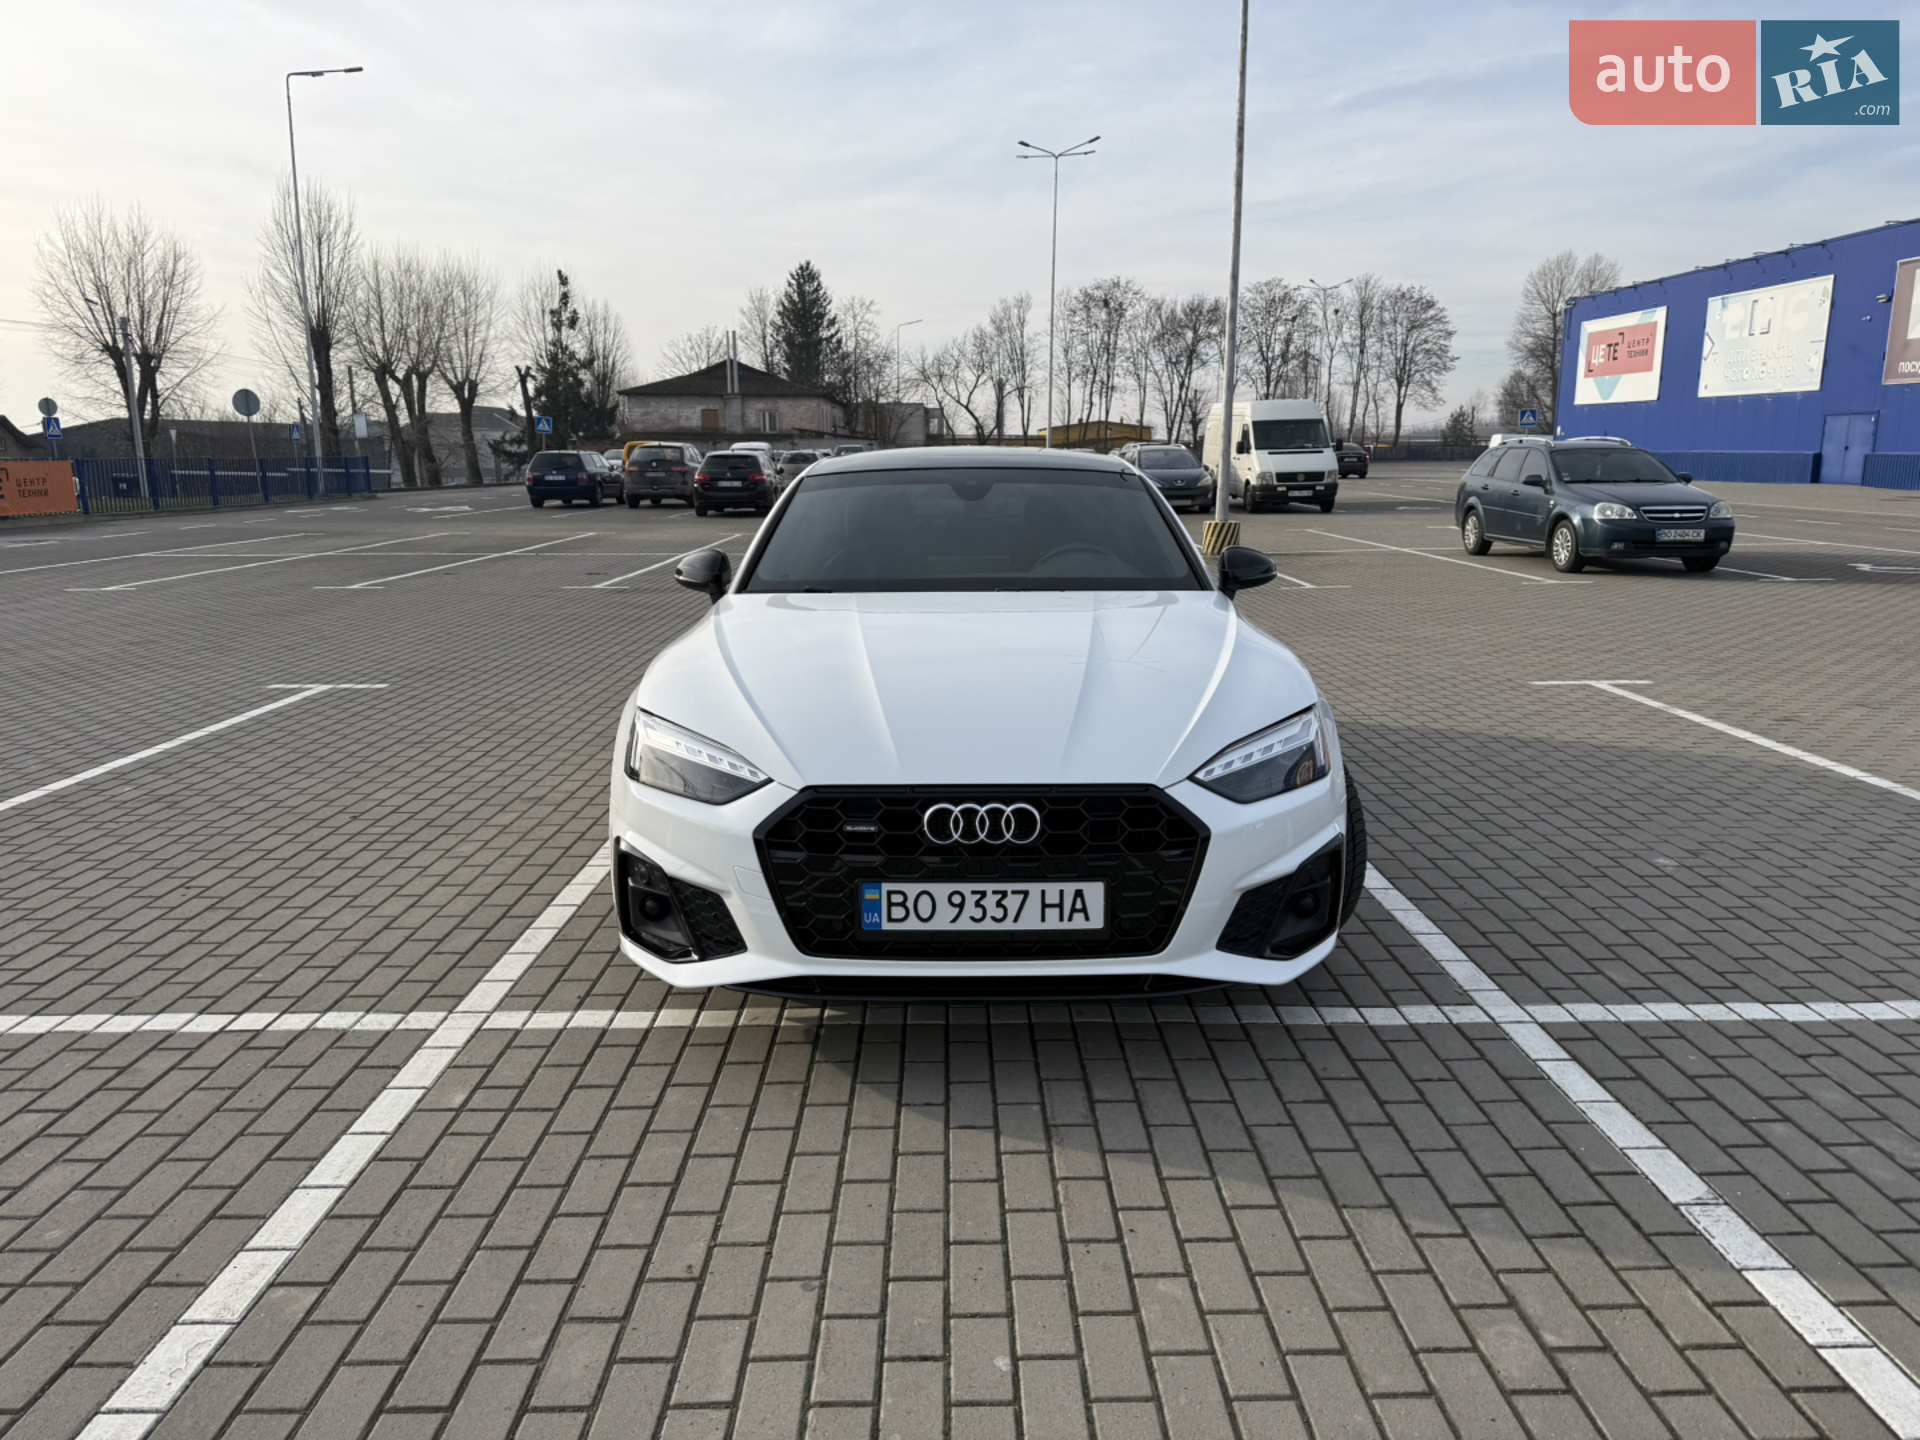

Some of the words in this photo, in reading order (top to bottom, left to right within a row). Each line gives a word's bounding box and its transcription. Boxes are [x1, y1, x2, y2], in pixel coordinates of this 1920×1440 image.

[1627, 337, 1650, 348] ЦЕНТР
[1591, 342, 1619, 366] ЦЕТЕ
[1898, 361, 1920, 374] ПОСУ
[15, 477, 48, 488] ЦЕНТР
[886, 890, 937, 923] BO
[947, 890, 1030, 923] 9337
[1040, 889, 1091, 923] HA
[864, 912, 880, 924] UA
